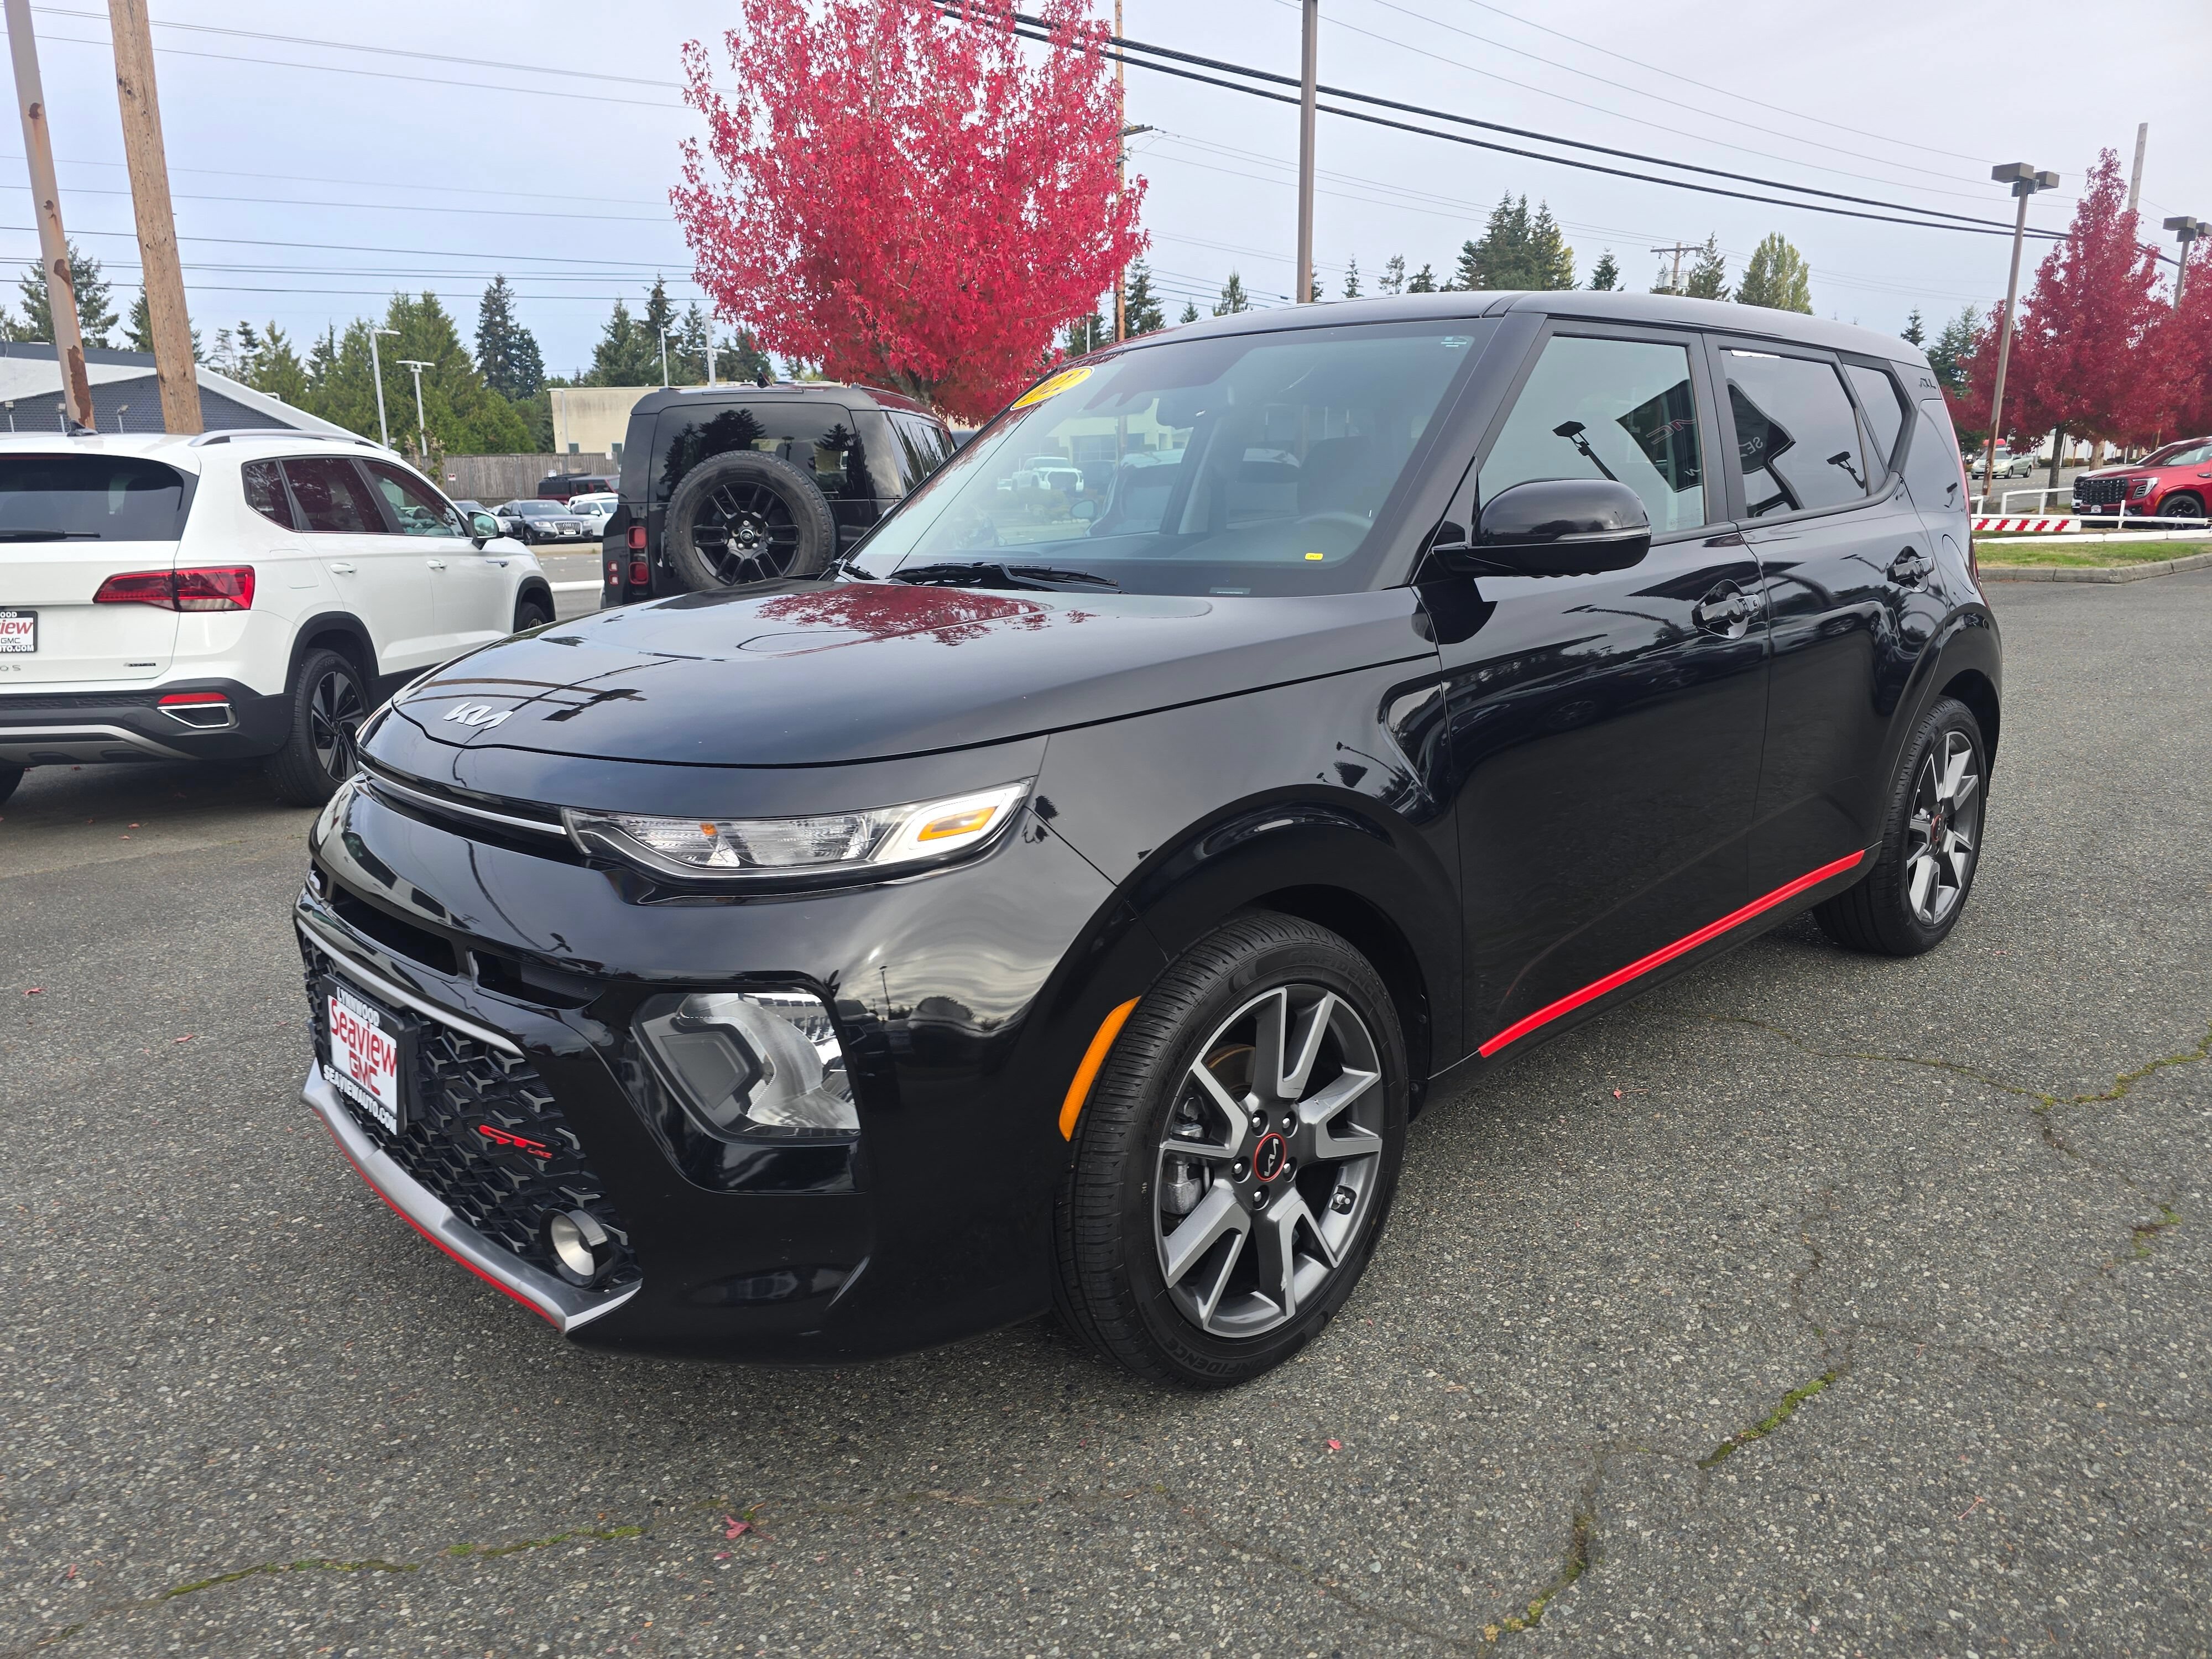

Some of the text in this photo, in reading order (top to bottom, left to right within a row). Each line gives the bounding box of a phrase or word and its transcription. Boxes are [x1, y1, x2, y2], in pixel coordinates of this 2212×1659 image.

[0, 619, 33, 634] iew
[337, 987, 380, 1027] LYNNWOOD
[331, 999, 397, 1078] Seaview
[349, 1050, 380, 1095] GMC
[323, 1064, 397, 1135] SEAVIEWAUTO.COM
